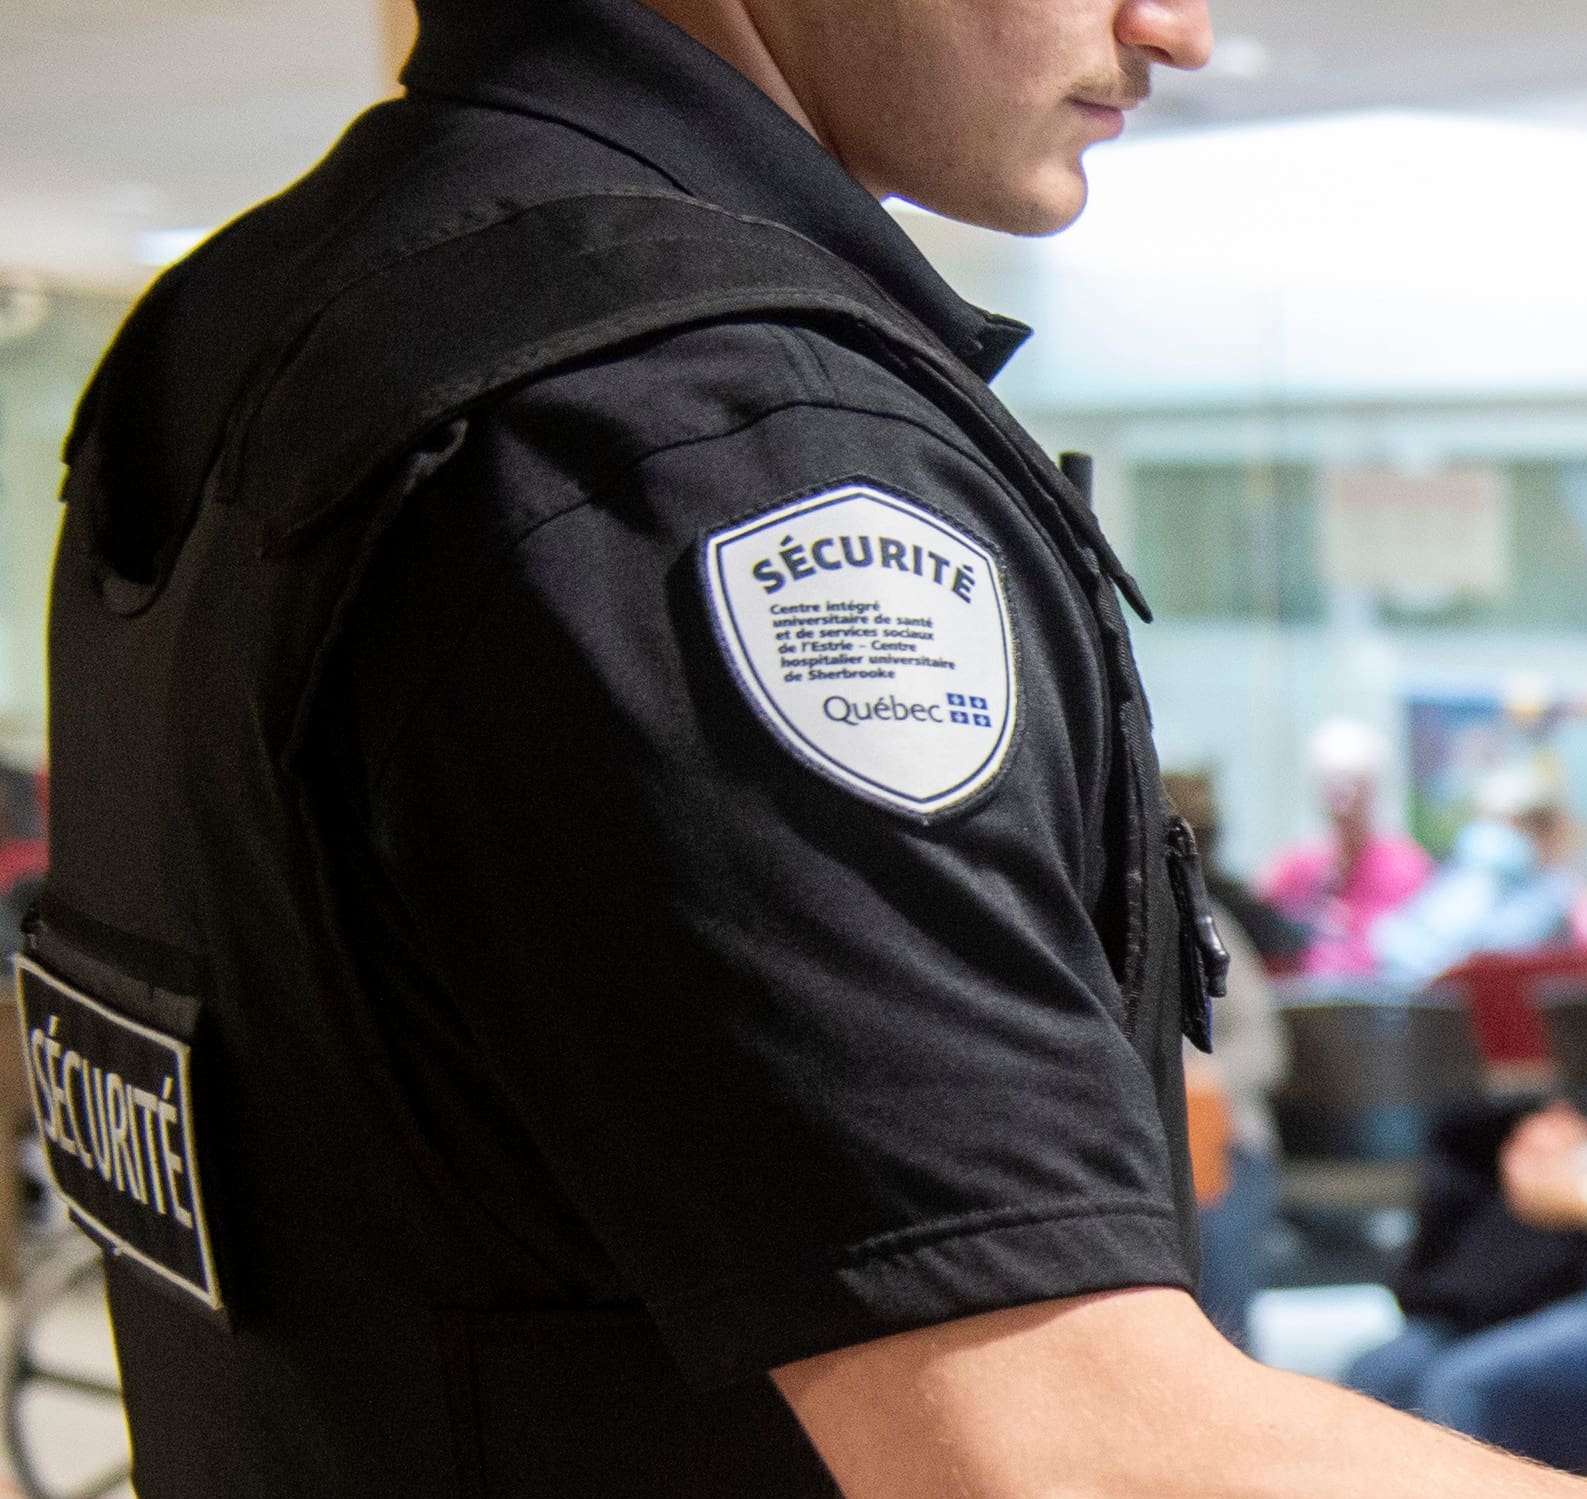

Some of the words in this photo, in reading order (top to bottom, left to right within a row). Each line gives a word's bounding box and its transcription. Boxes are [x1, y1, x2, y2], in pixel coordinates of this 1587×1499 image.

[752, 534, 976, 603] SÉCURITÉ
[770, 603, 820, 615] Centre
[826, 601, 880, 613] intégré
[773, 614, 869, 627] universitaire
[874, 614, 891, 625] de
[896, 617, 933, 628] santé
[775, 630, 790, 640] et
[796, 628, 814, 639] de
[820, 628, 878, 638] services
[883, 629, 934, 640] sociaux
[778, 643, 796, 654] de
[871, 640, 917, 651] Centre
[781, 654, 864, 668] hospitalier
[869, 653, 956, 670] universitaire
[784, 671, 802, 682] de
[808, 668, 896, 681] Sherbrooke
[823, 695, 943, 726] Québec
[31, 1014, 193, 1229] SÉCURITÉ
